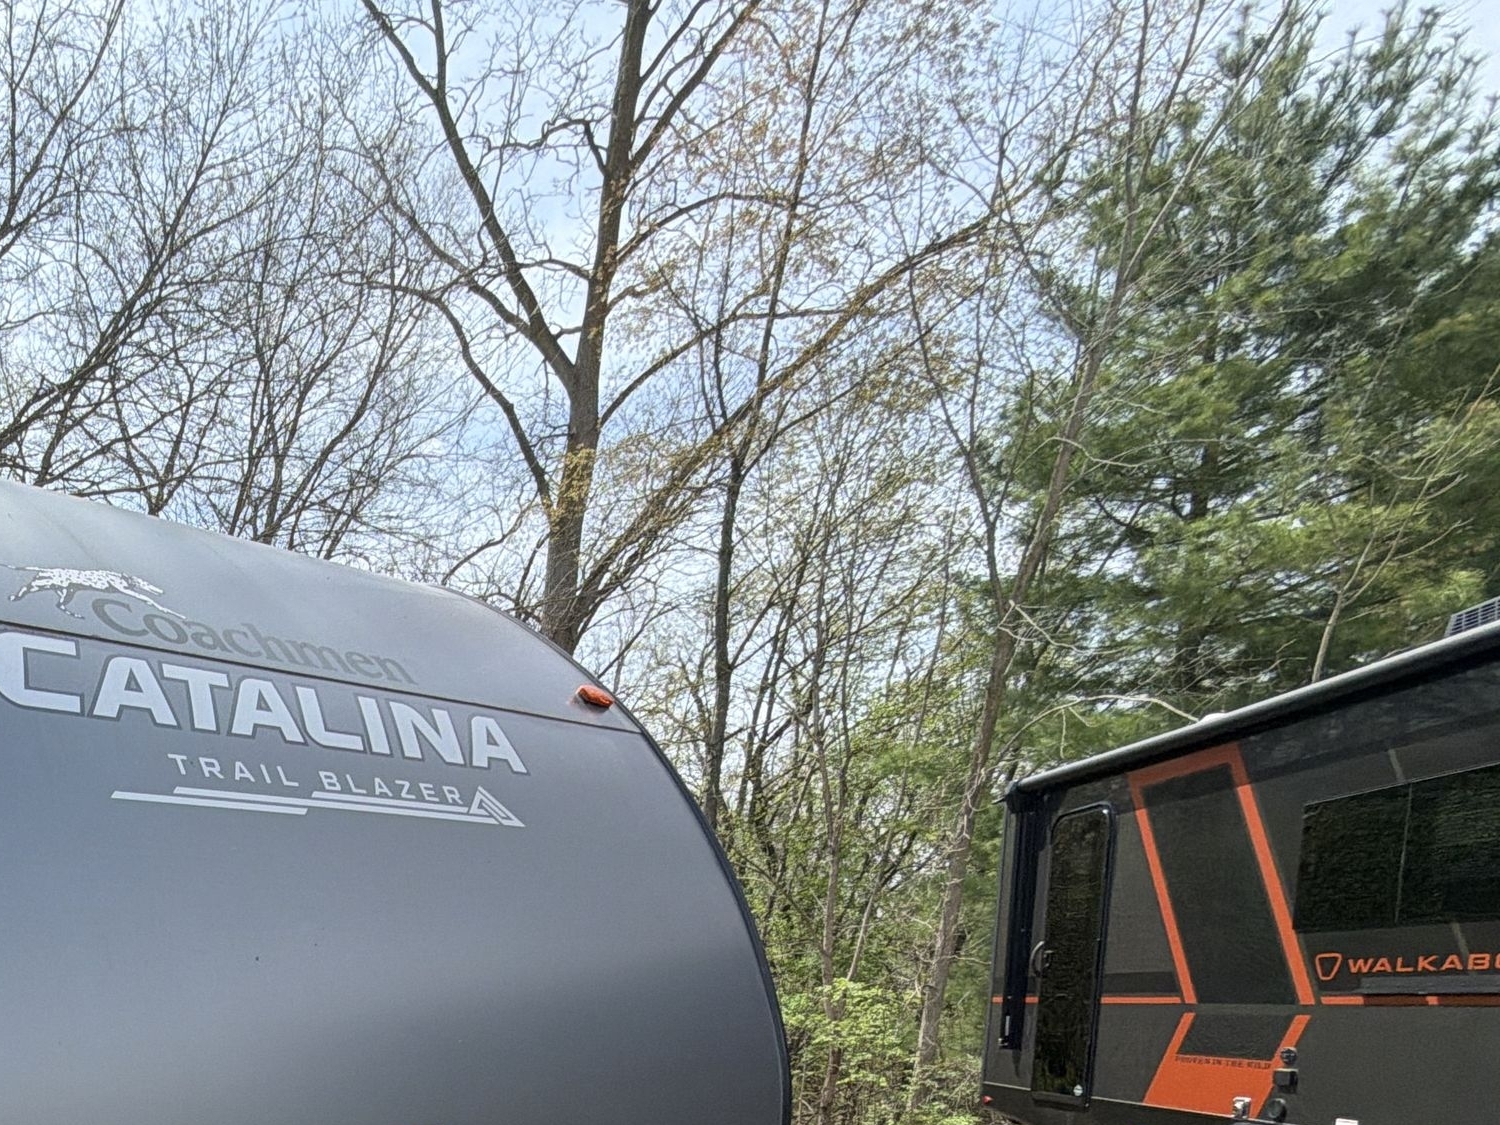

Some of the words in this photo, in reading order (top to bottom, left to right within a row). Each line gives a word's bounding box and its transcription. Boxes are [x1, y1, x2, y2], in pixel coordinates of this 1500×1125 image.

[92, 598, 417, 685] Coachmen
[166, 752, 300, 787] TRAIL
[318, 770, 464, 805] BLAZER
